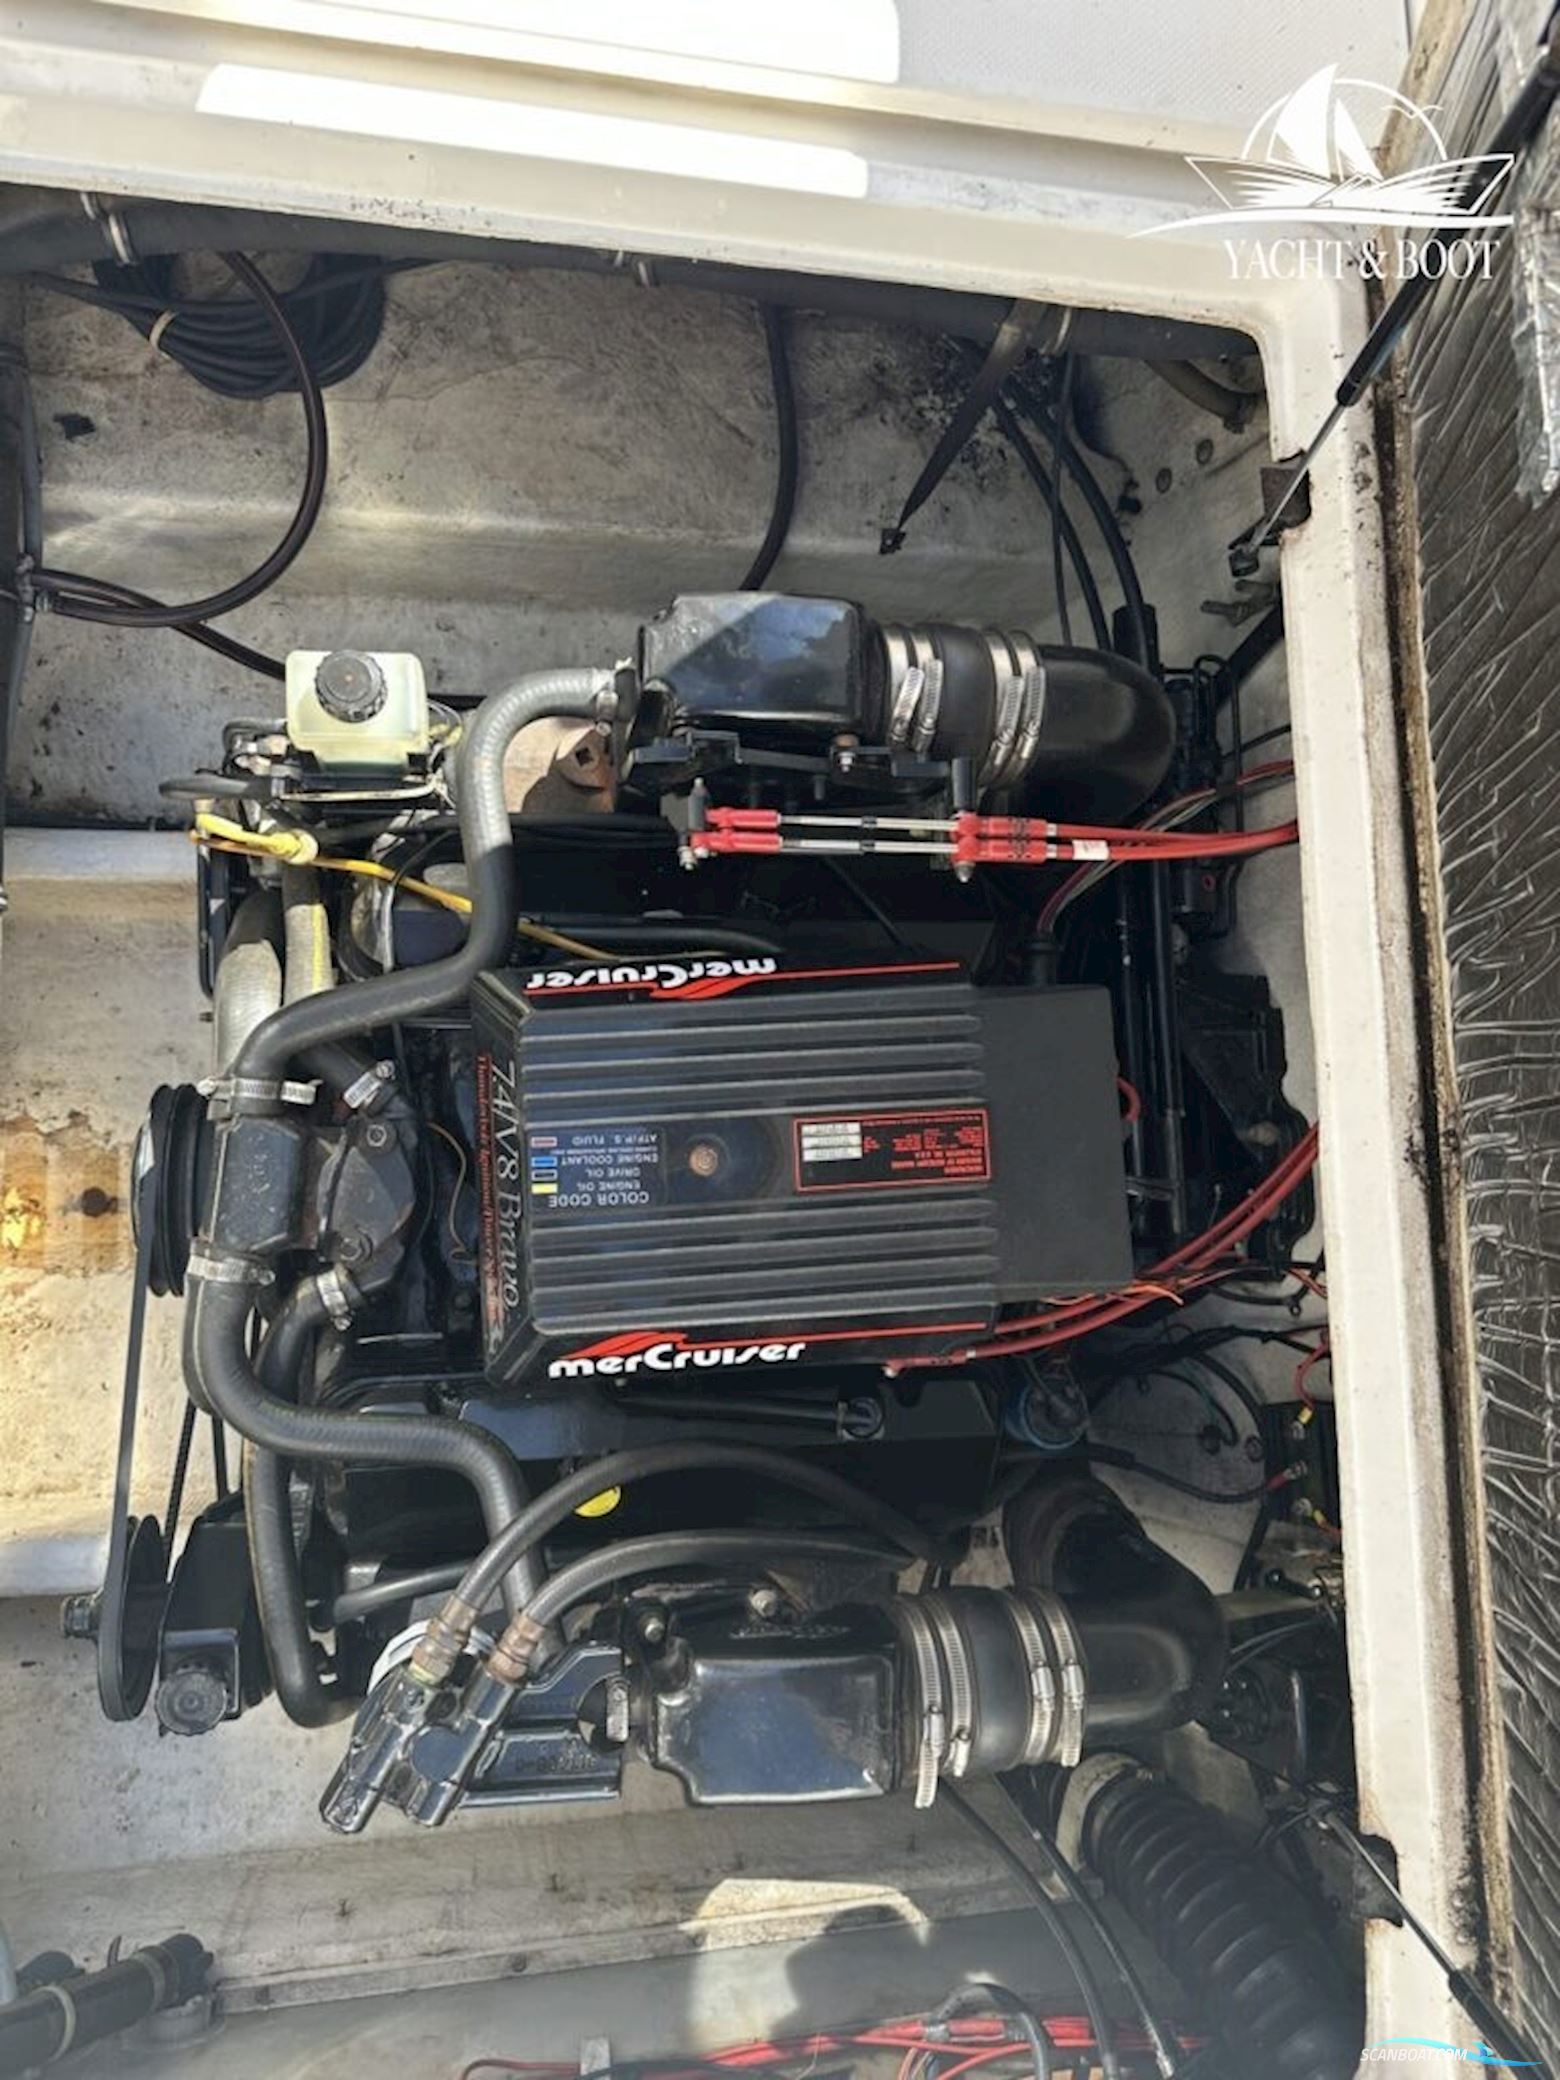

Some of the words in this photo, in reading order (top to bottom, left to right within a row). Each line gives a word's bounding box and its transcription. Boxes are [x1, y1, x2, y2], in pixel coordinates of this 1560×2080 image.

[526, 957, 777, 989] merCruiser
[572, 1135, 605, 1146] FLUID
[561, 1154, 614, 1166] COOLANT
[617, 1153, 658, 1164] ENGINE
[586, 1169, 605, 1178] OIL
[608, 1167, 641, 1178] DRIVE
[576, 1182, 596, 1192] OIL
[599, 1181, 641, 1191] ENGINE
[549, 1194, 592, 1208] CODE
[597, 1191, 650, 1206] COLOR
[498, 1192, 522, 1308] Bravo
[548, 1343, 806, 1378] merCruiser
